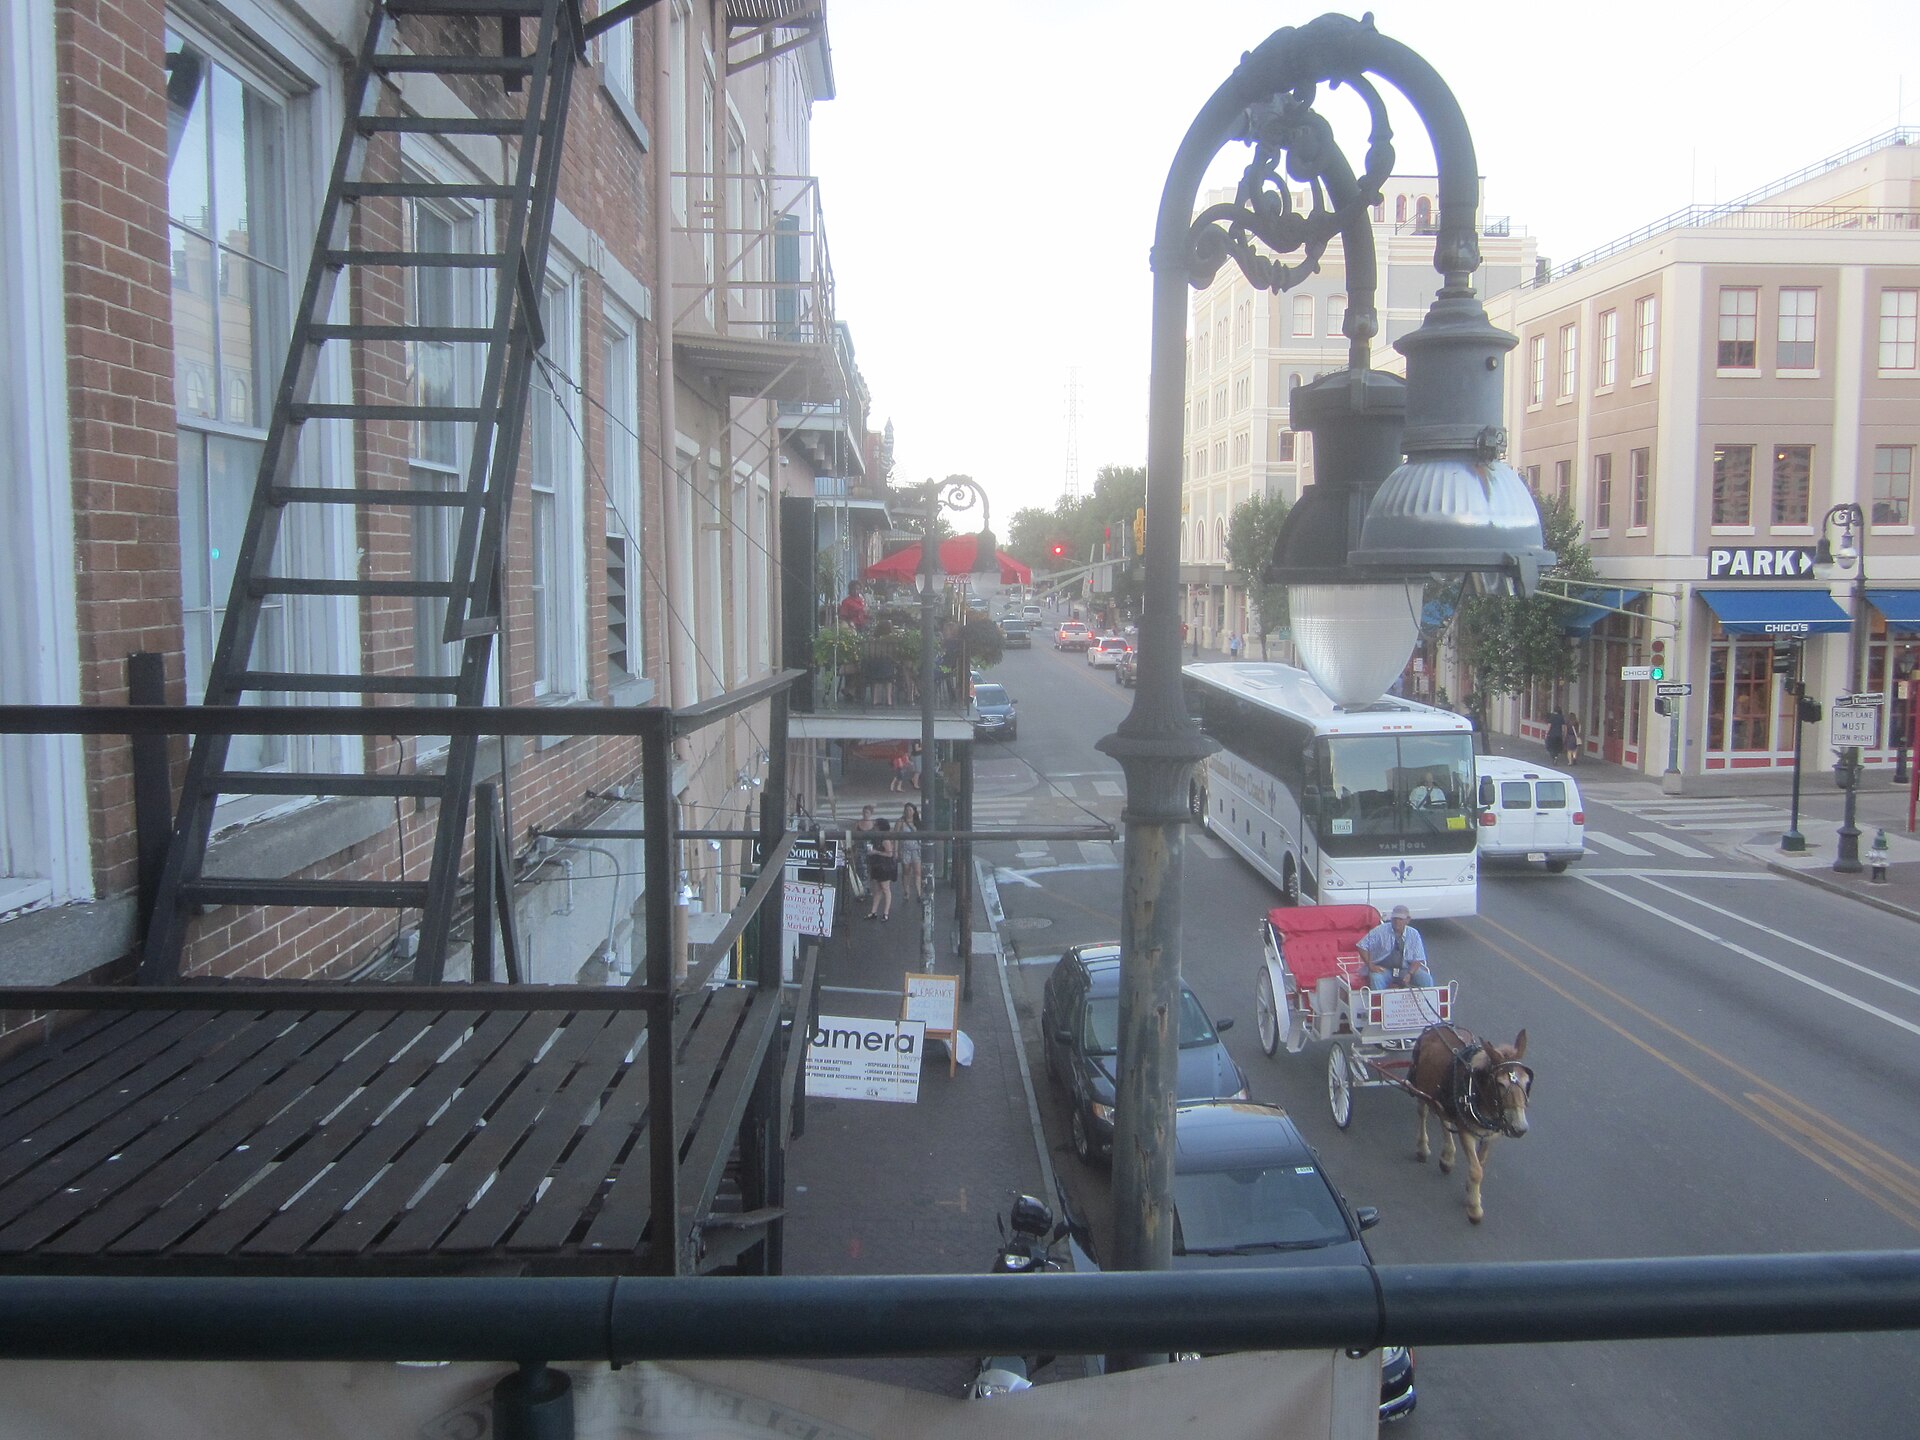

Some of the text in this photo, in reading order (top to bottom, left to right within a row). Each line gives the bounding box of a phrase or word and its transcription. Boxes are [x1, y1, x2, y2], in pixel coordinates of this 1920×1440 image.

[1710, 550, 1796, 576] PARK
[1764, 623, 1809, 632] CHICO'S
[1841, 722, 1865, 730] MUST
[784, 884, 819, 896] SALE
[811, 1028, 915, 1054] amera
